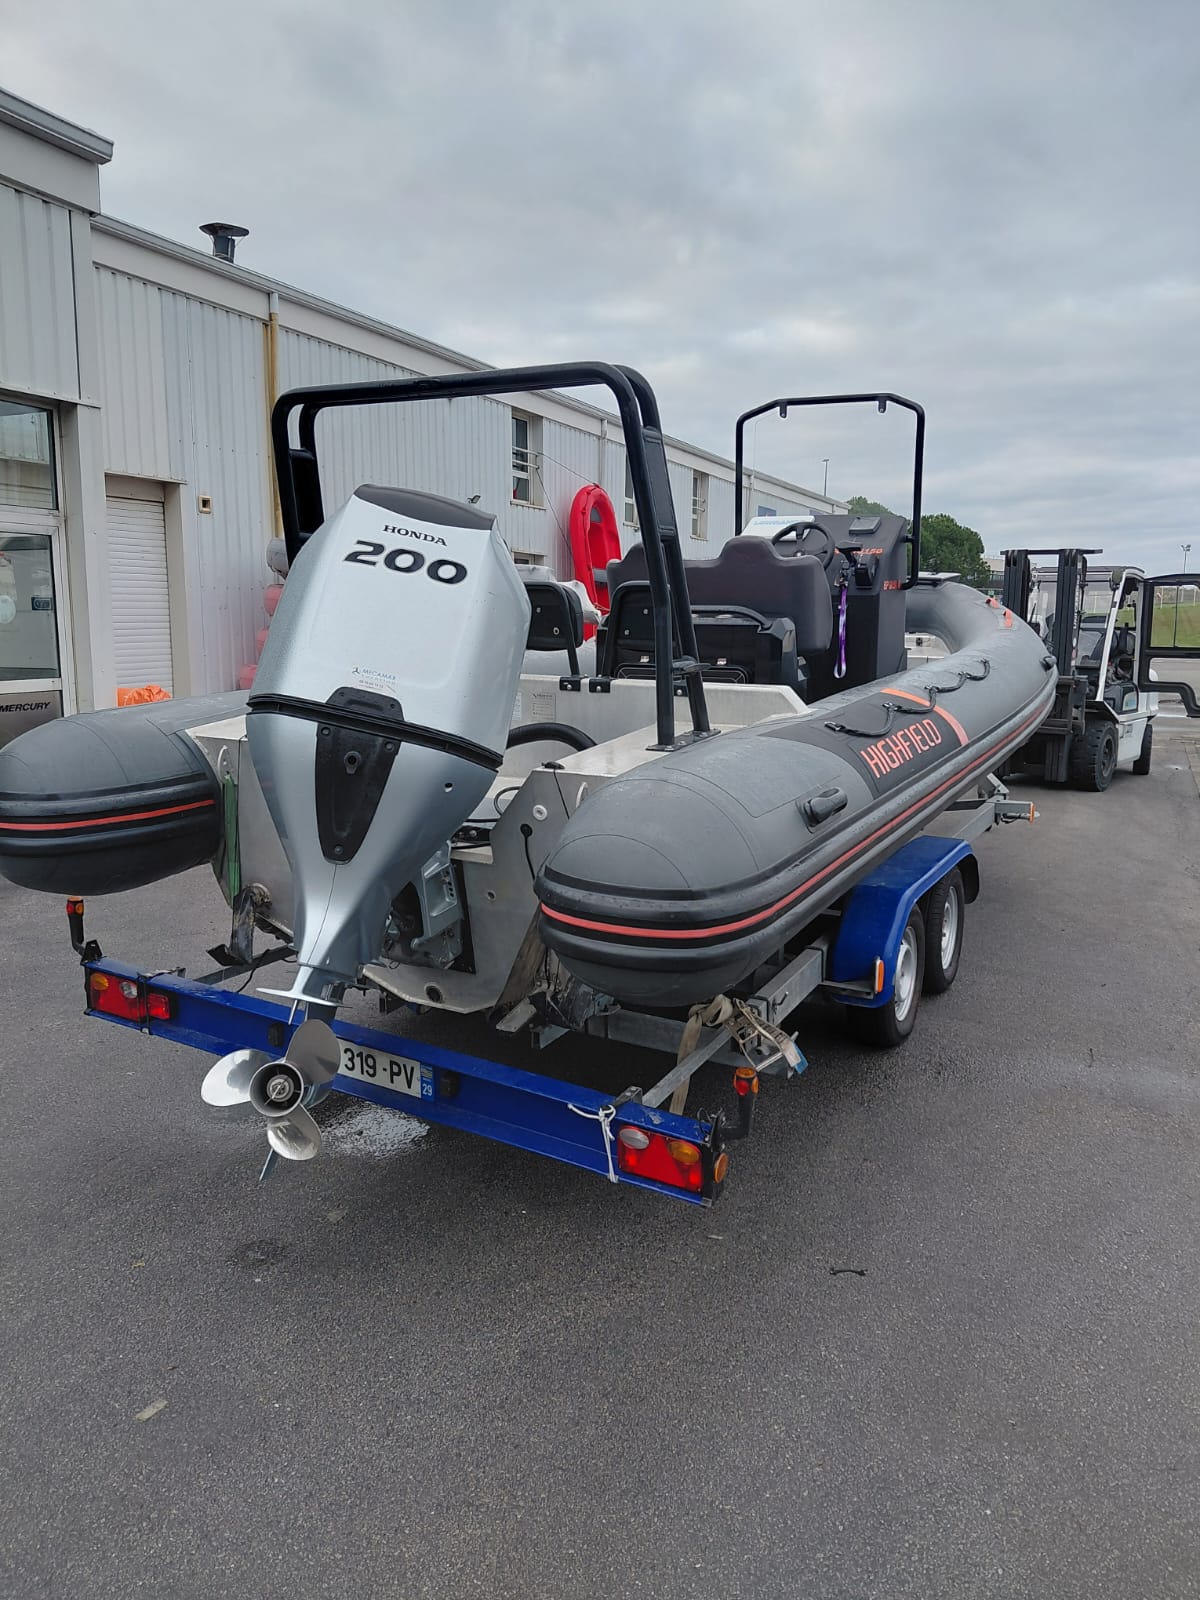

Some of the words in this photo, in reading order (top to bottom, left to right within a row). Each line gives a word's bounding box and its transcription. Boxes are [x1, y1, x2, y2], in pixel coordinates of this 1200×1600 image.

[383, 525, 447, 546] HONDA
[344, 540, 468, 584] 200
[0, 702, 50, 713] MERCURY
[860, 719, 942, 778] HIGHFIELD
[422, 1083, 433, 1096] 29
